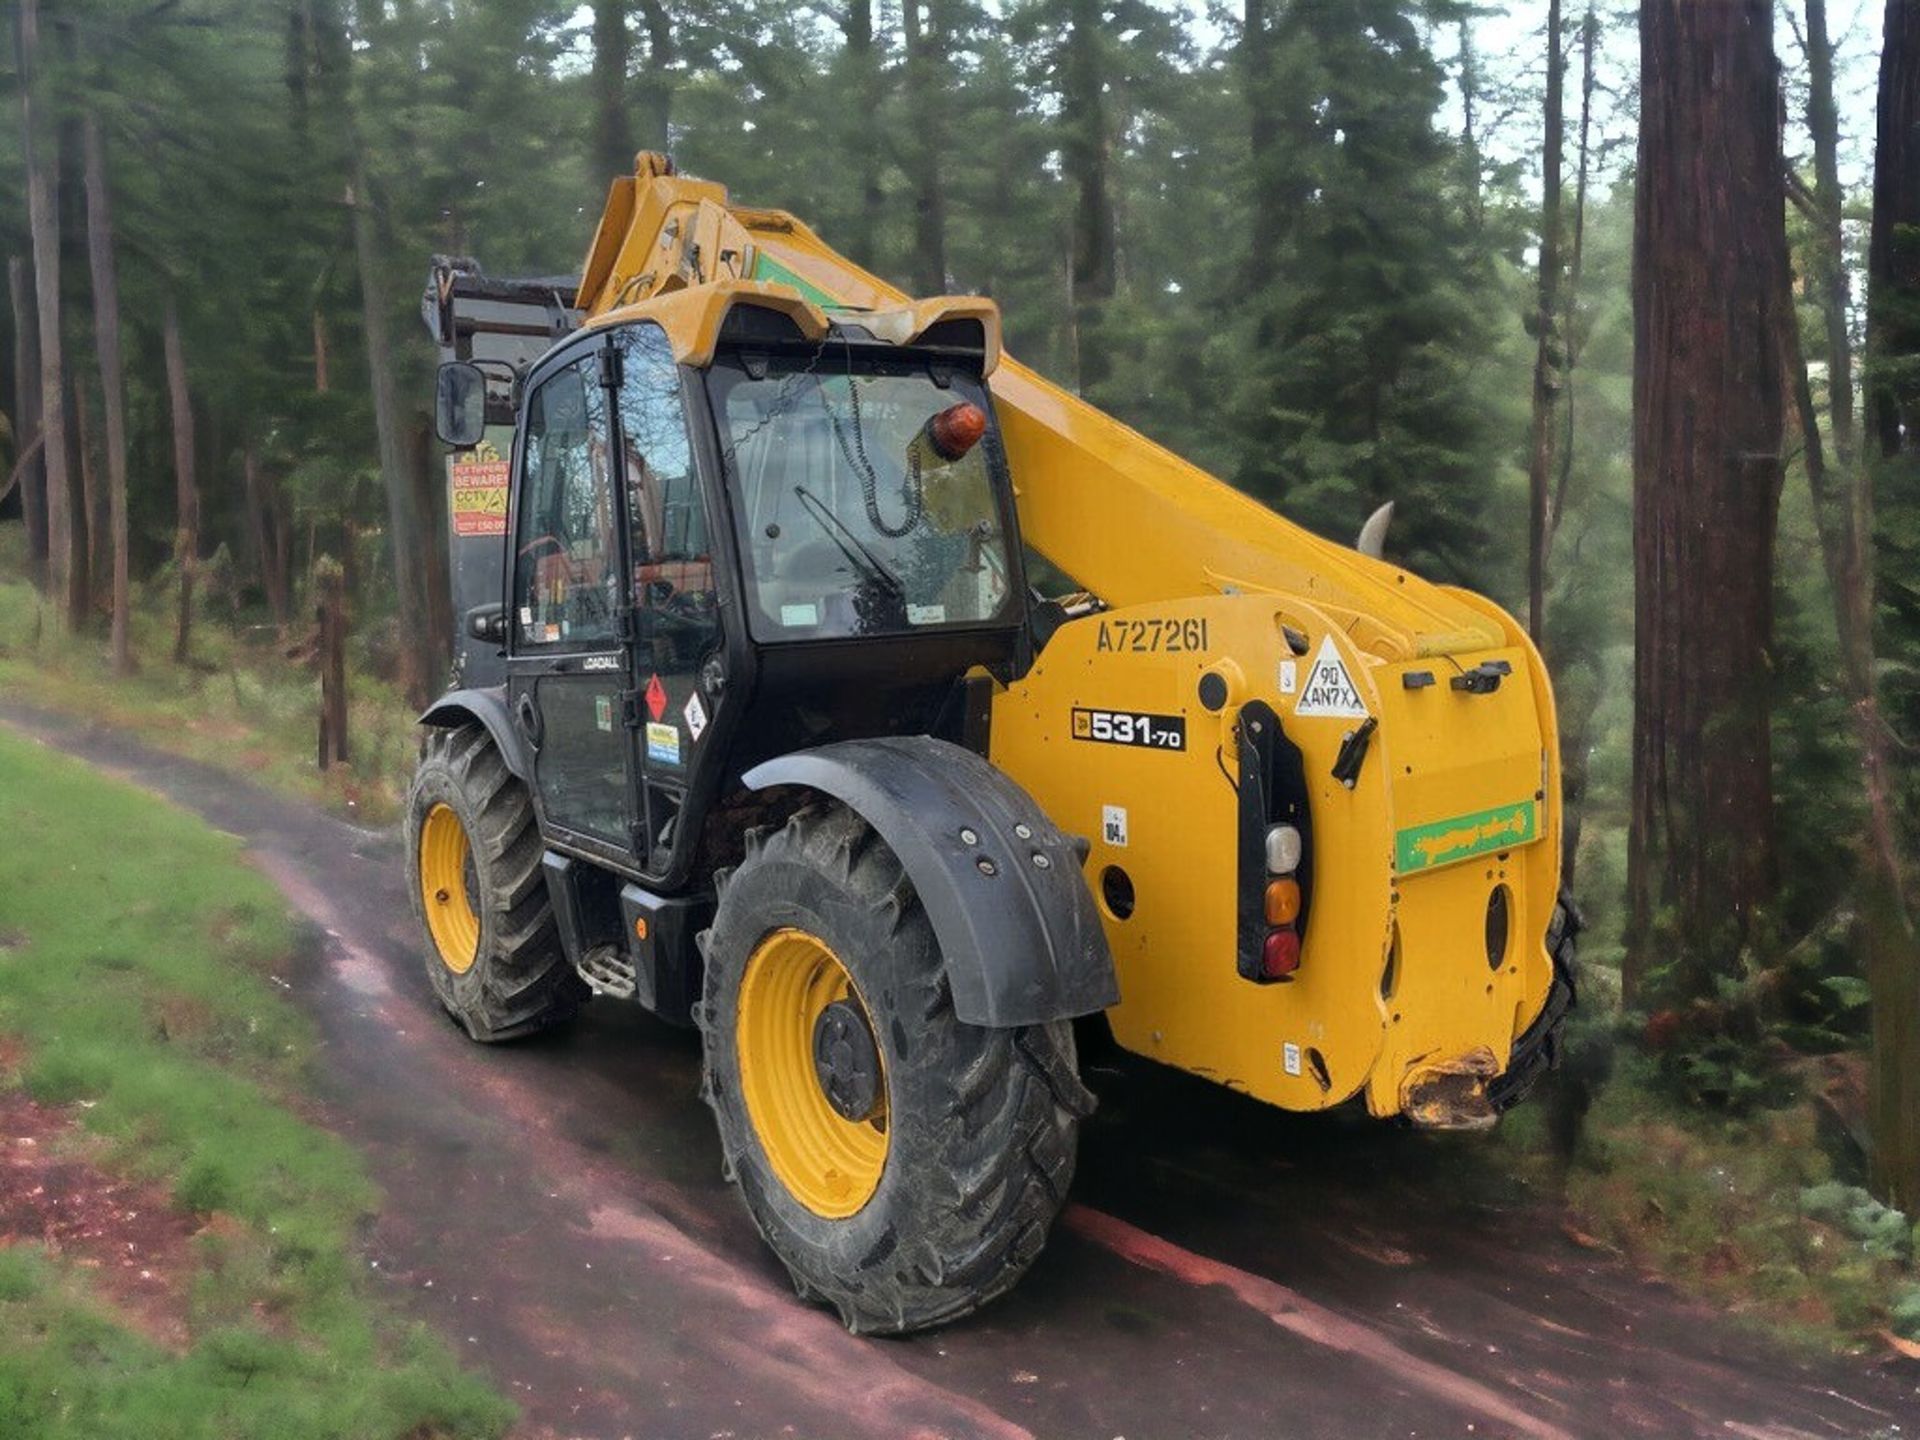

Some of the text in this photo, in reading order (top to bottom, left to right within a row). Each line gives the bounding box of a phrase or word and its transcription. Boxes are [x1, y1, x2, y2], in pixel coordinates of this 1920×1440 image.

[455, 490, 488, 502] CCTV
[1097, 618, 1208, 652] A727261
[1311, 687, 1352, 707] AN7X
